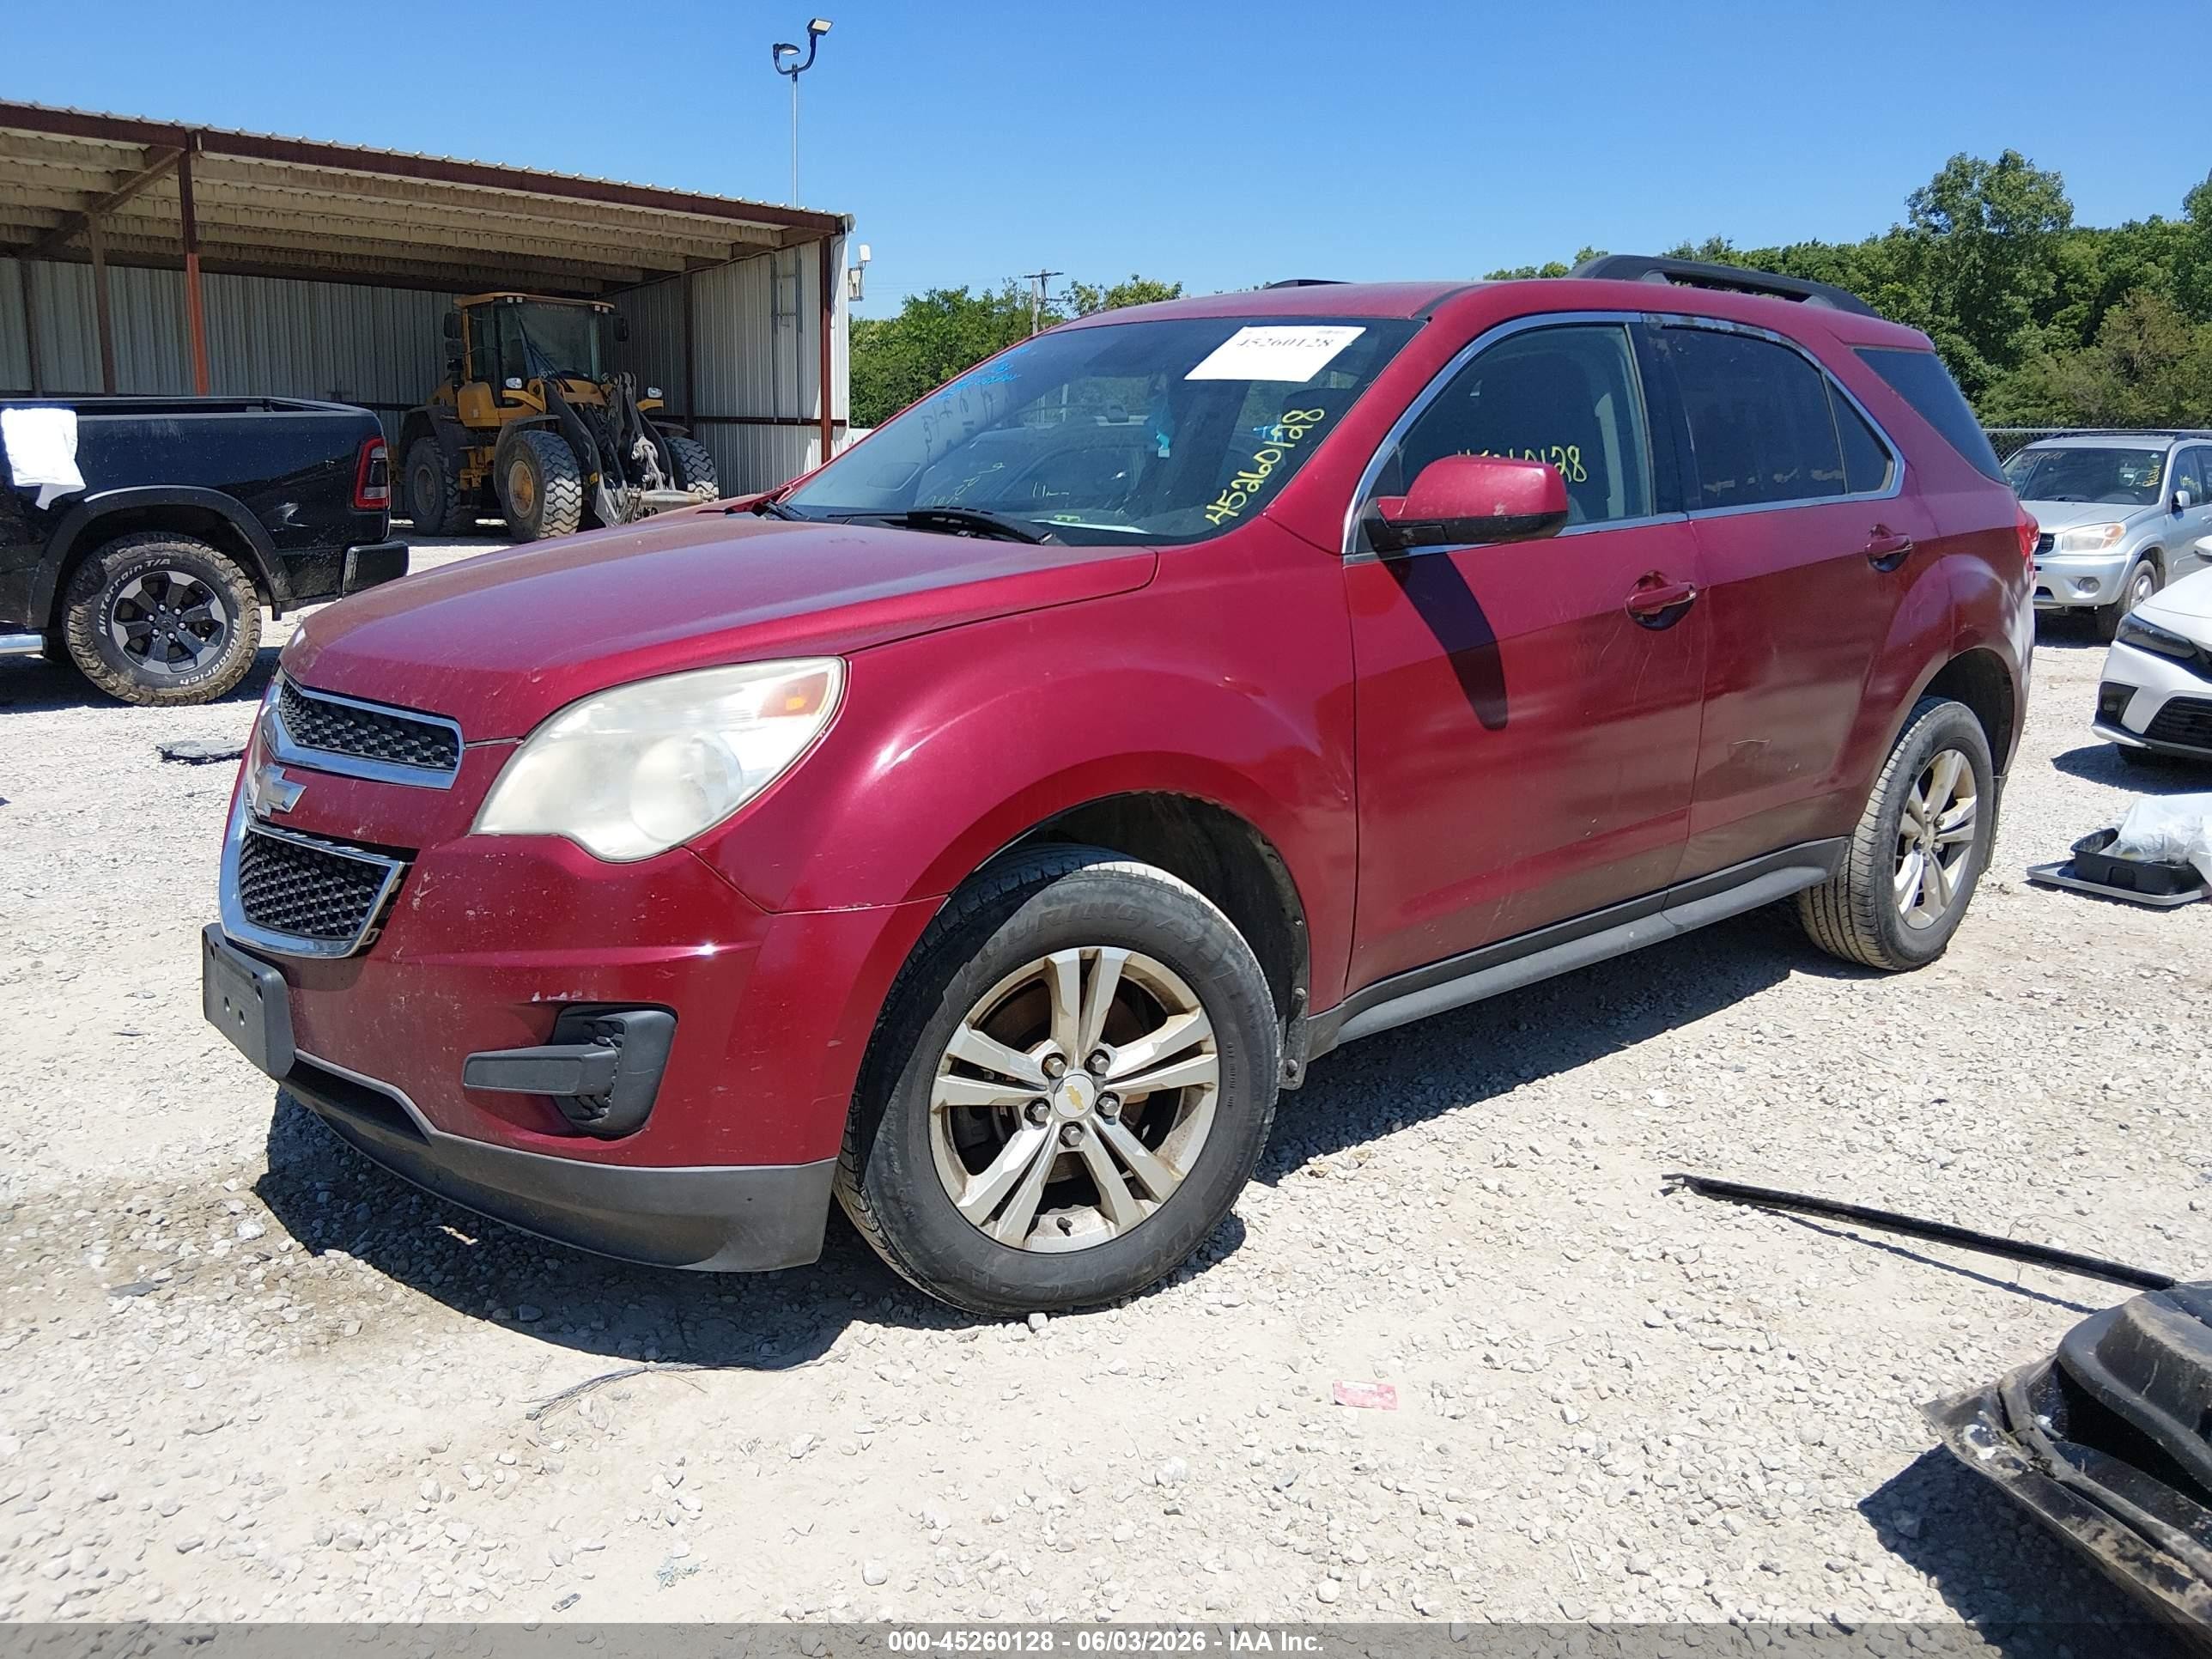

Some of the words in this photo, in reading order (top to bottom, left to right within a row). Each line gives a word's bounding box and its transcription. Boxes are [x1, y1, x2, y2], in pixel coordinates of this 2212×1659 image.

[1204, 407, 1326, 526] 45260128
[98, 563, 143, 636] All-Terrain
[144, 558, 171, 568] T/A
